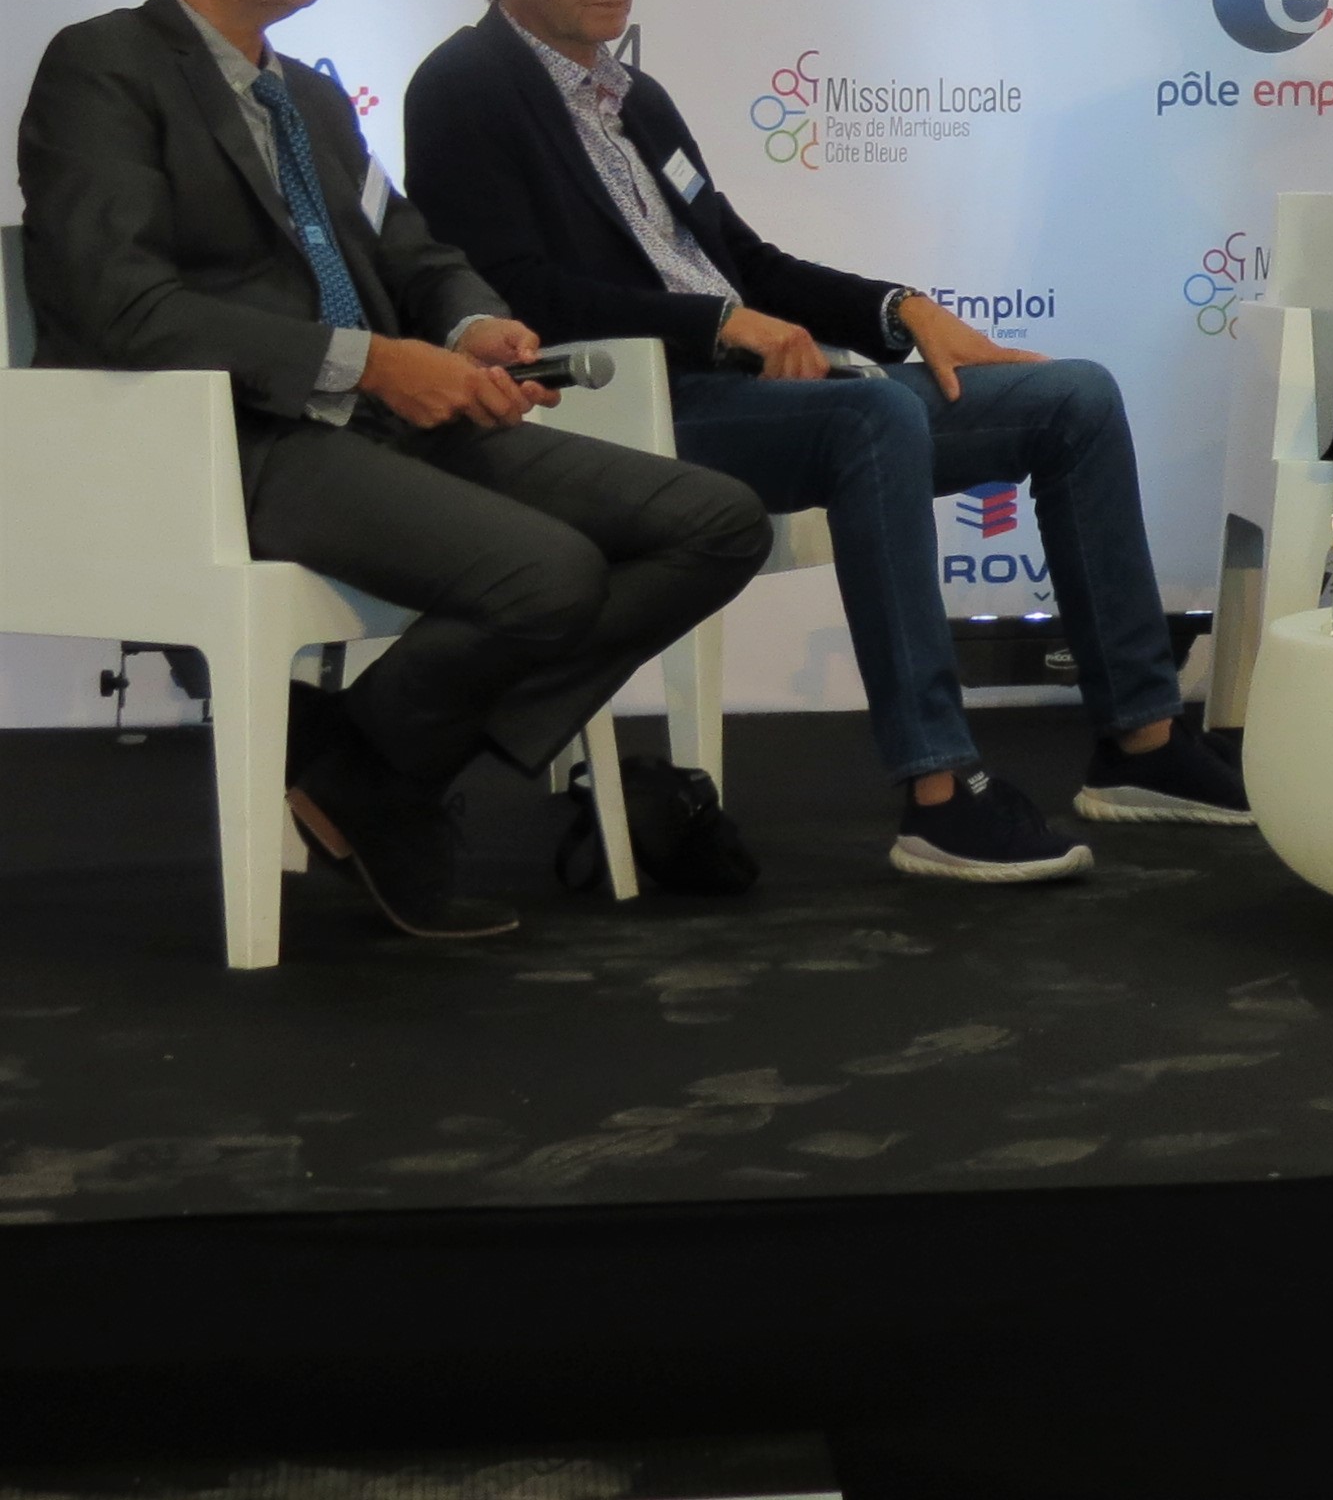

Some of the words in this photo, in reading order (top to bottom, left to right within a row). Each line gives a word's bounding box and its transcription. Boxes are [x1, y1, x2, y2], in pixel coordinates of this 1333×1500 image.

[825, 76, 931, 115] Mission
[938, 78, 1022, 115] Locale
[1156, 72, 1239, 115] pôle
[825, 117, 861, 140] Pays
[865, 117, 885, 136] de
[889, 116, 970, 141] Martigues
[825, 141, 860, 164] Côte
[864, 143, 908, 164] Bleue
[931, 288, 1055, 325] 'Emploi
